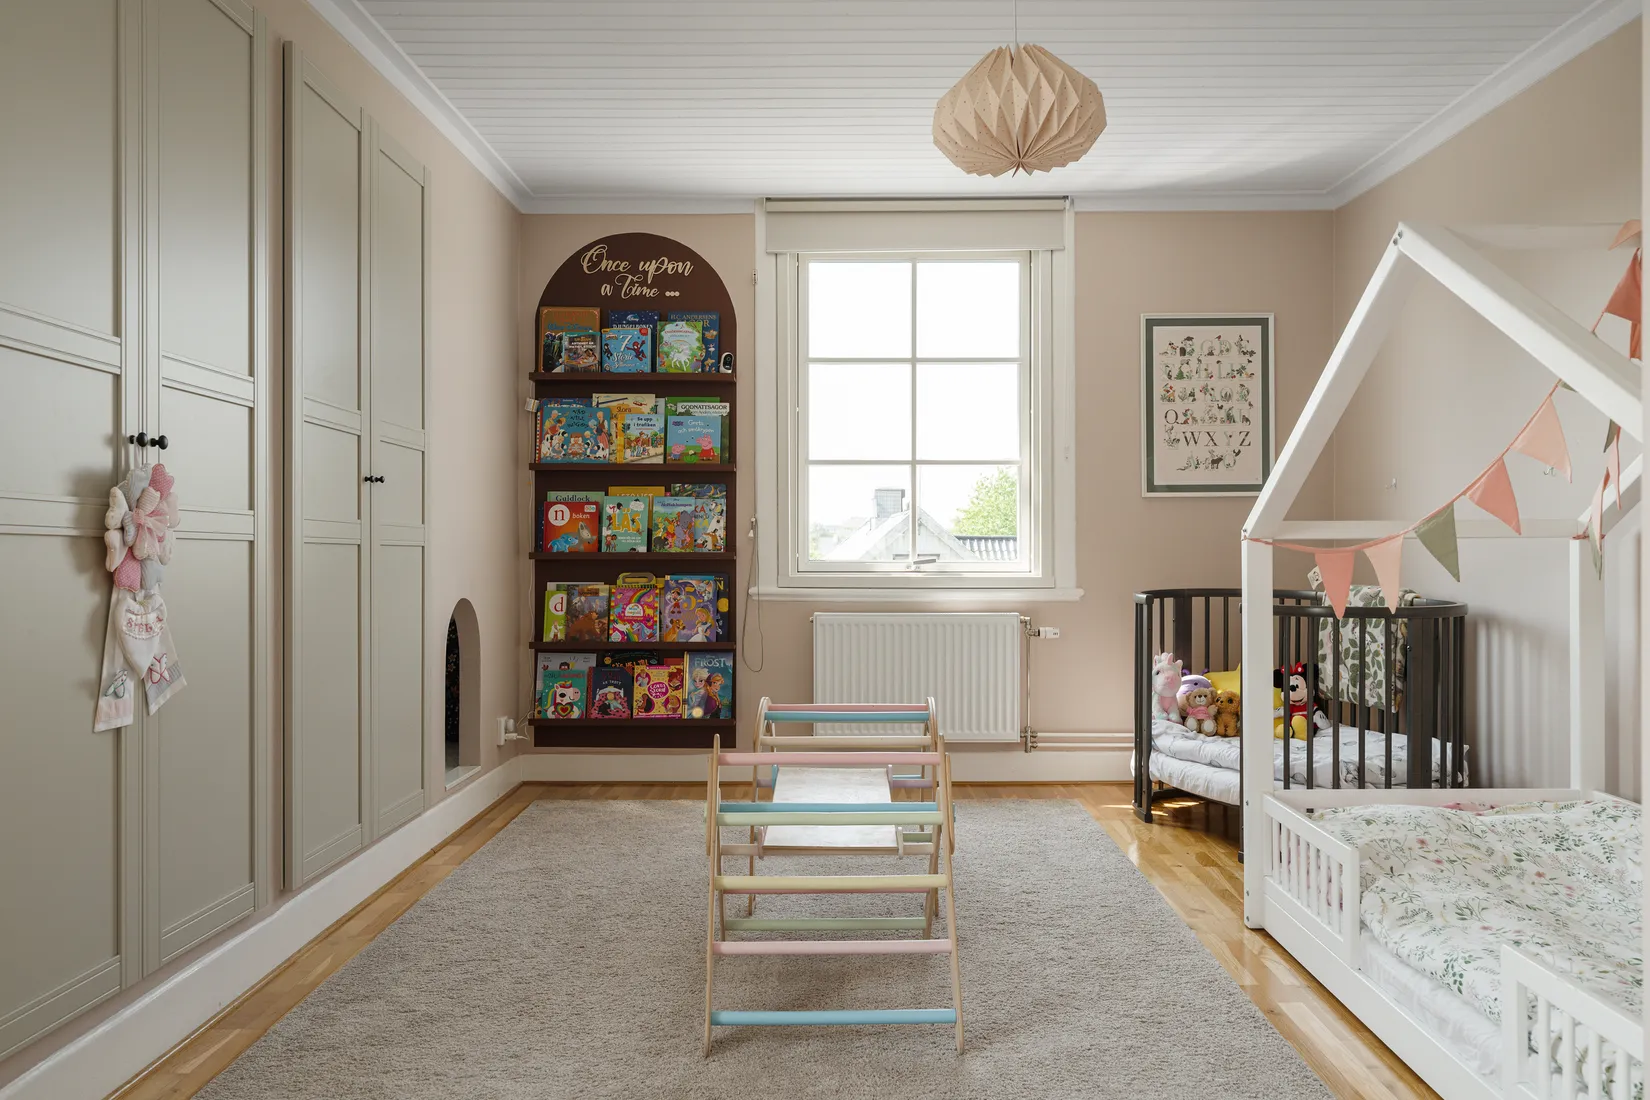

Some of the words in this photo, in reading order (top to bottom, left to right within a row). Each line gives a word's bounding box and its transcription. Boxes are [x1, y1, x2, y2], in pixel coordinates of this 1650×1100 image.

[580, 244, 632, 274] Once
[638, 256, 694, 284] upon
[600, 283, 614, 296] a
[614, 273, 660, 299] Time
[1164, 409, 1184, 425] Q
[554, 508, 566, 521] n
[611, 507, 642, 533] LÄS
[554, 596, 564, 612] d
[694, 657, 727, 668] FROST
